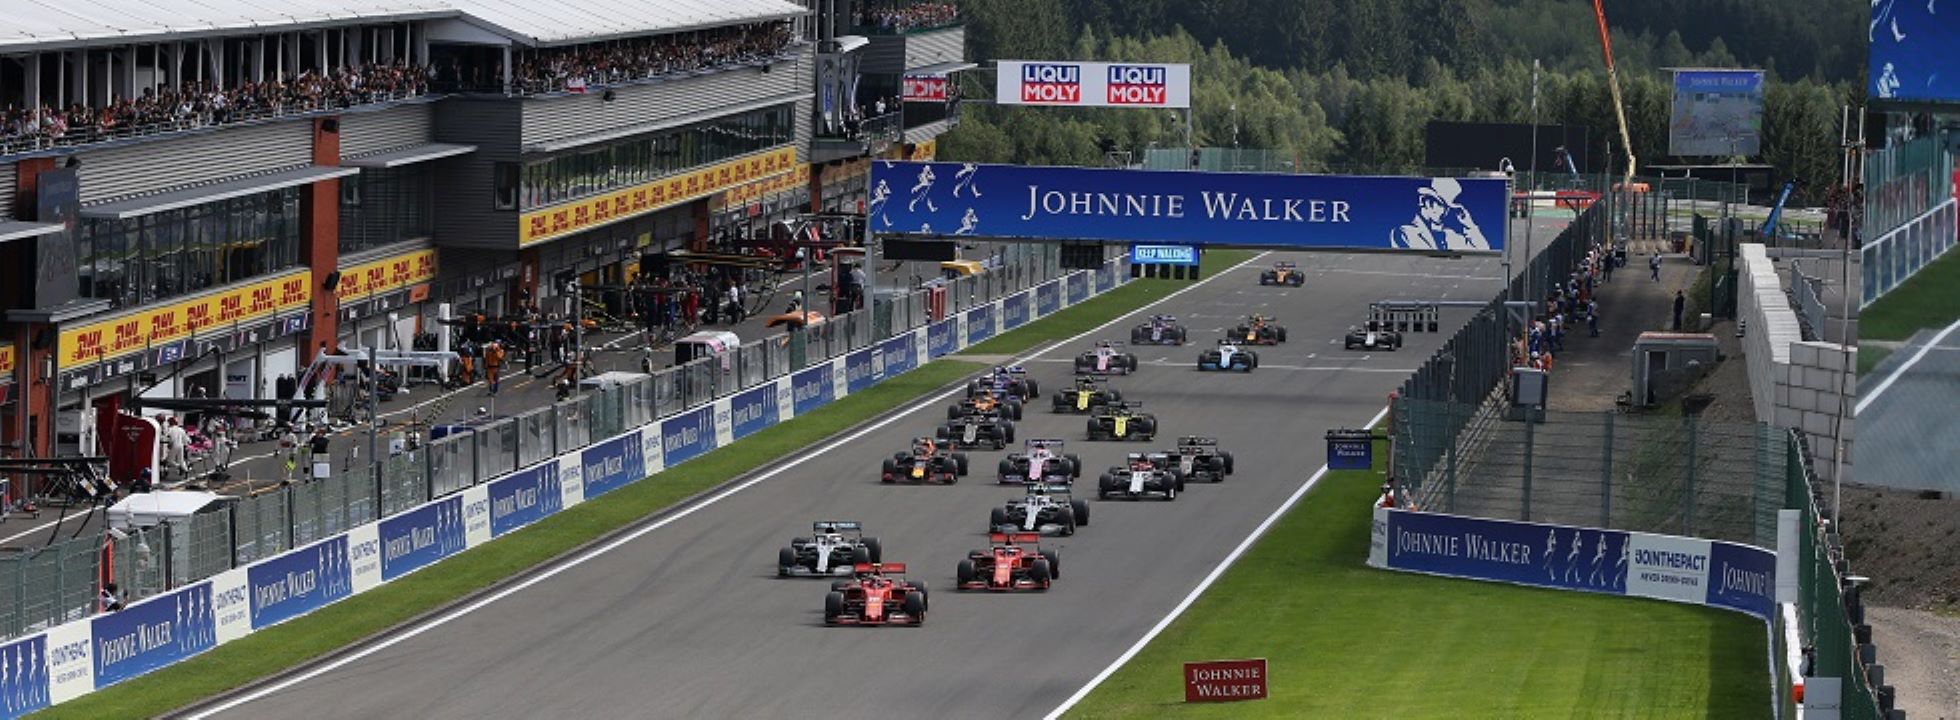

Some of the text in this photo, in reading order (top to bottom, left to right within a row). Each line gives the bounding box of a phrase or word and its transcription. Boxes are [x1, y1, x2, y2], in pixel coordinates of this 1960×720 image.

[1025, 65, 1078, 82] LIQUI
[1111, 67, 1163, 84] LIQUI
[1025, 85, 1078, 100] MOLY
[1110, 86, 1164, 102] MOLY
[1021, 186, 1350, 223] JOHNNIE WALKER
[1395, 525, 1458, 557] JOHNNIE
[1464, 532, 1530, 565] WALKER
[99, 634, 136, 677] JOHNNIE
[137, 620, 172, 654] WALKER
[1191, 667, 1260, 684] JOHNNIE
[1197, 683, 1261, 697] WALKER
